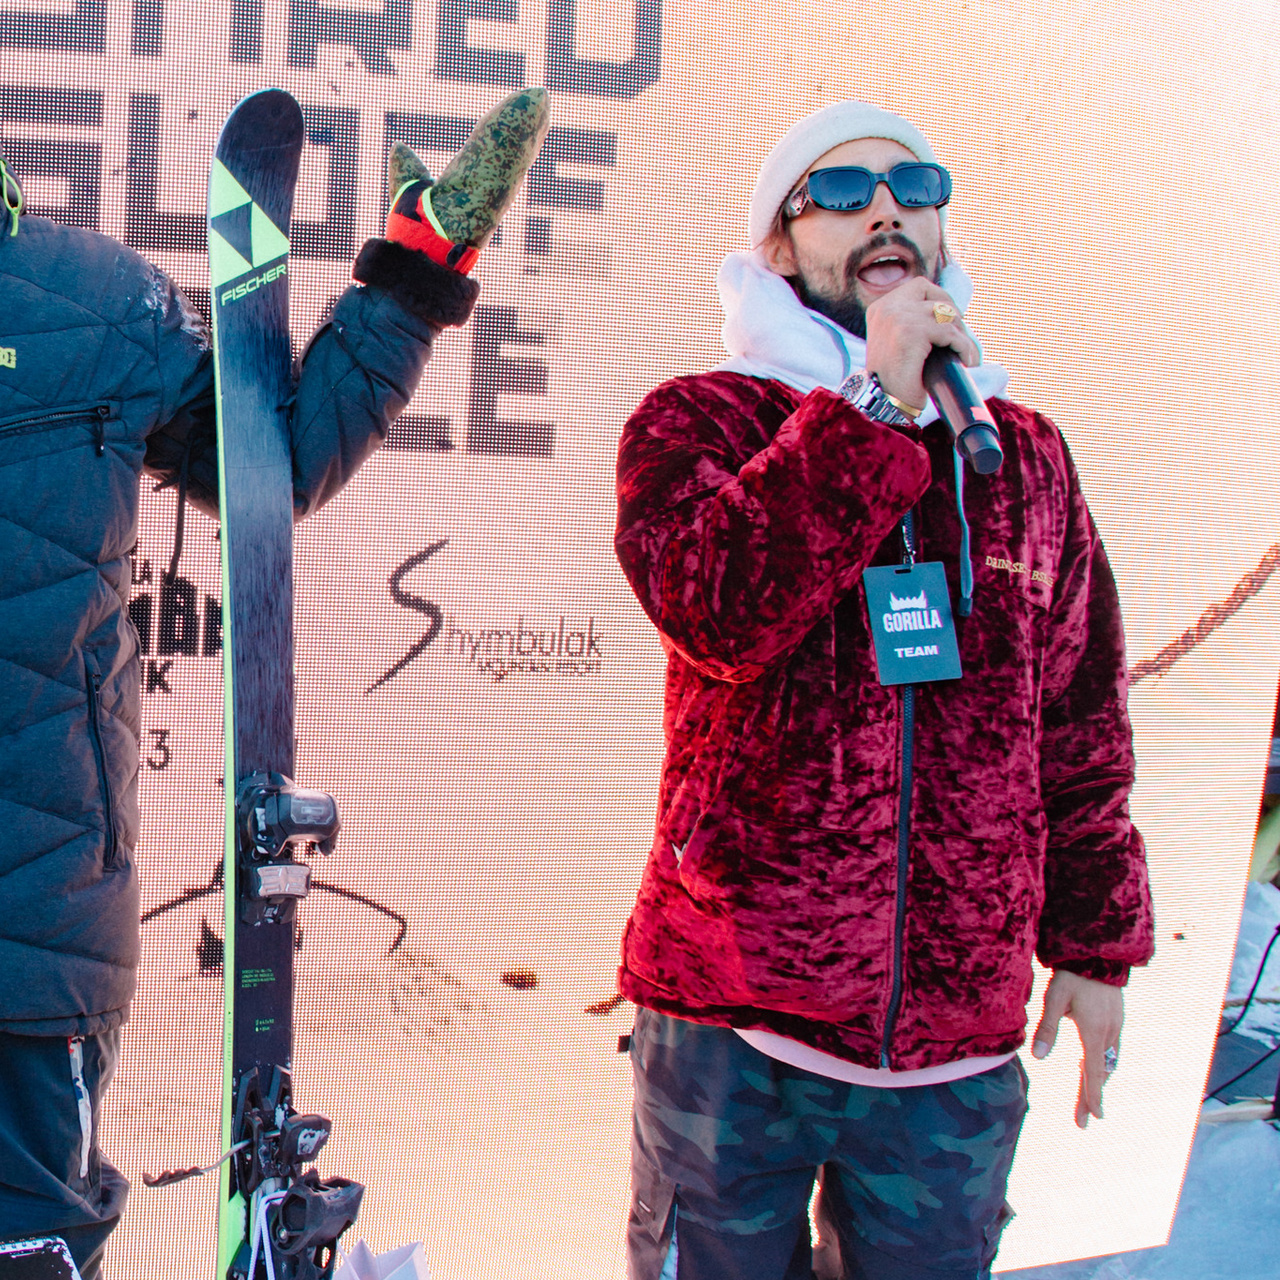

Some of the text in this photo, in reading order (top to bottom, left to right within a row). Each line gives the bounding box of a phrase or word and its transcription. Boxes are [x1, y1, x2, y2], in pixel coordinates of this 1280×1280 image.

[221, 263, 287, 307] FISCHER
[882, 608, 944, 633] GORILLA
[894, 645, 939, 658] TEAM
